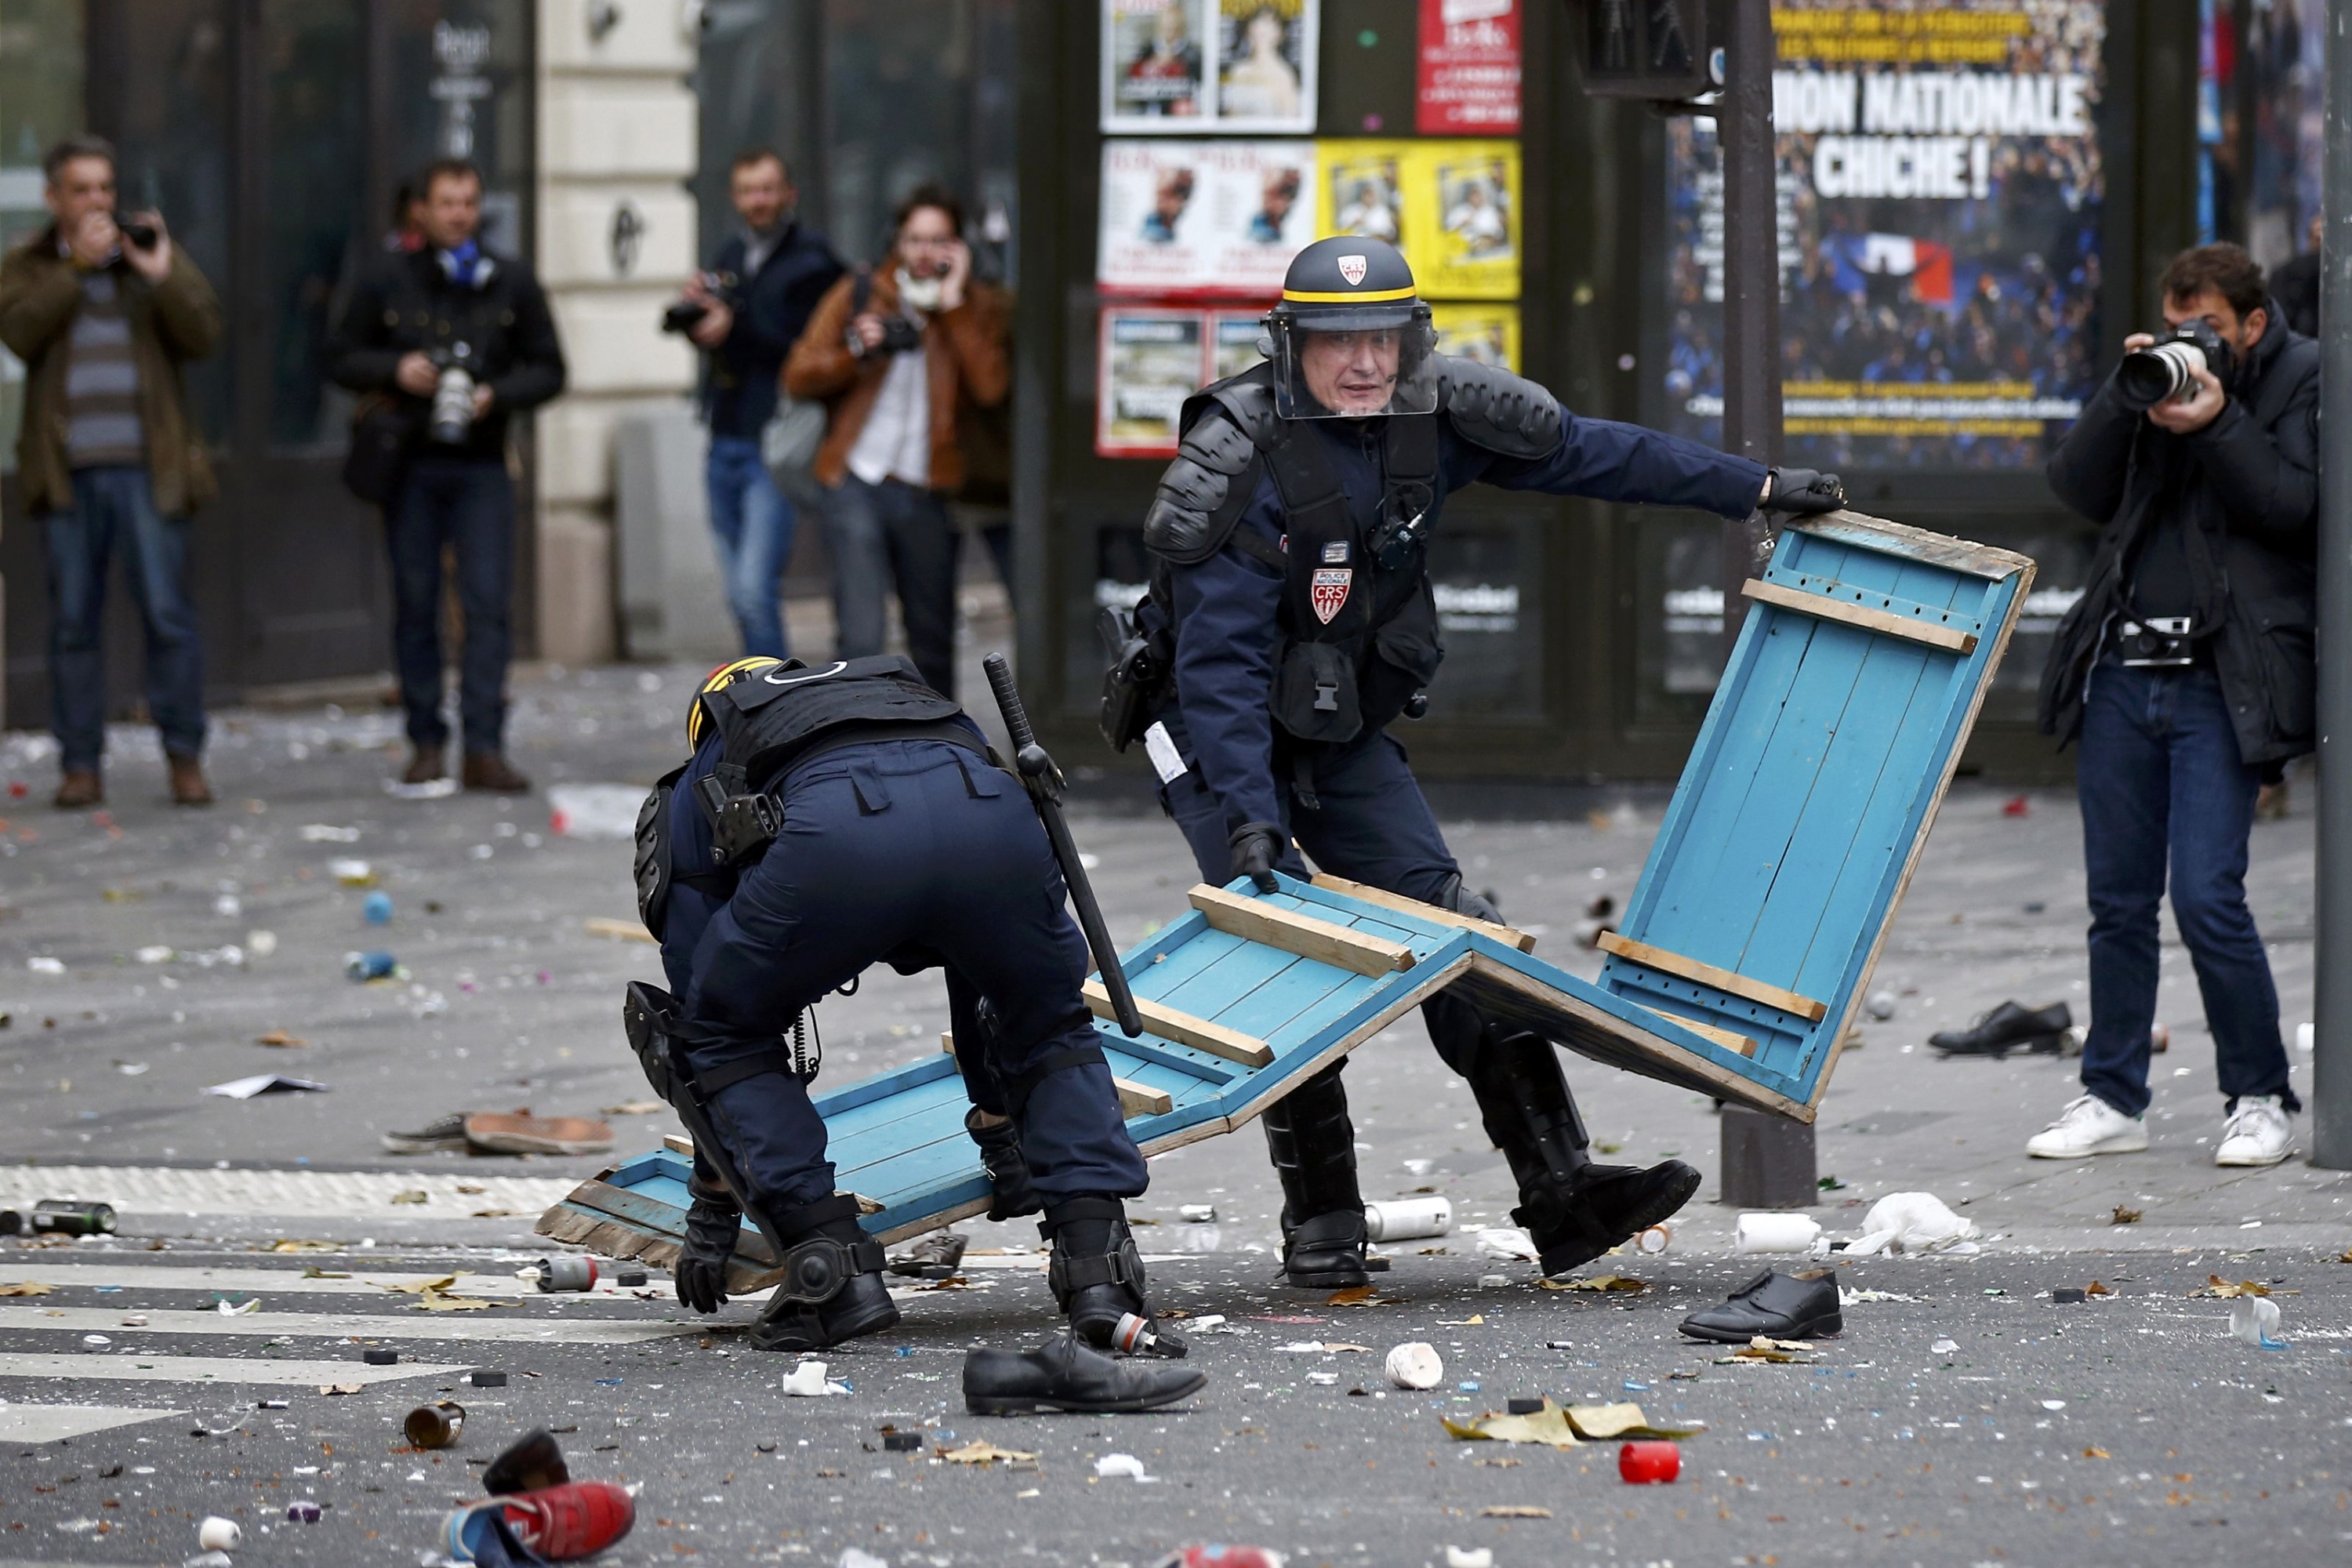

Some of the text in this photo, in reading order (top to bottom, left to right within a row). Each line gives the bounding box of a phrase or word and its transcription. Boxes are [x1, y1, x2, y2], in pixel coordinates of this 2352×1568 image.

[1863, 71, 2086, 135] NATIONALE
[1342, 263, 1363, 273] CRS
[1316, 586, 1344, 599] CRS
